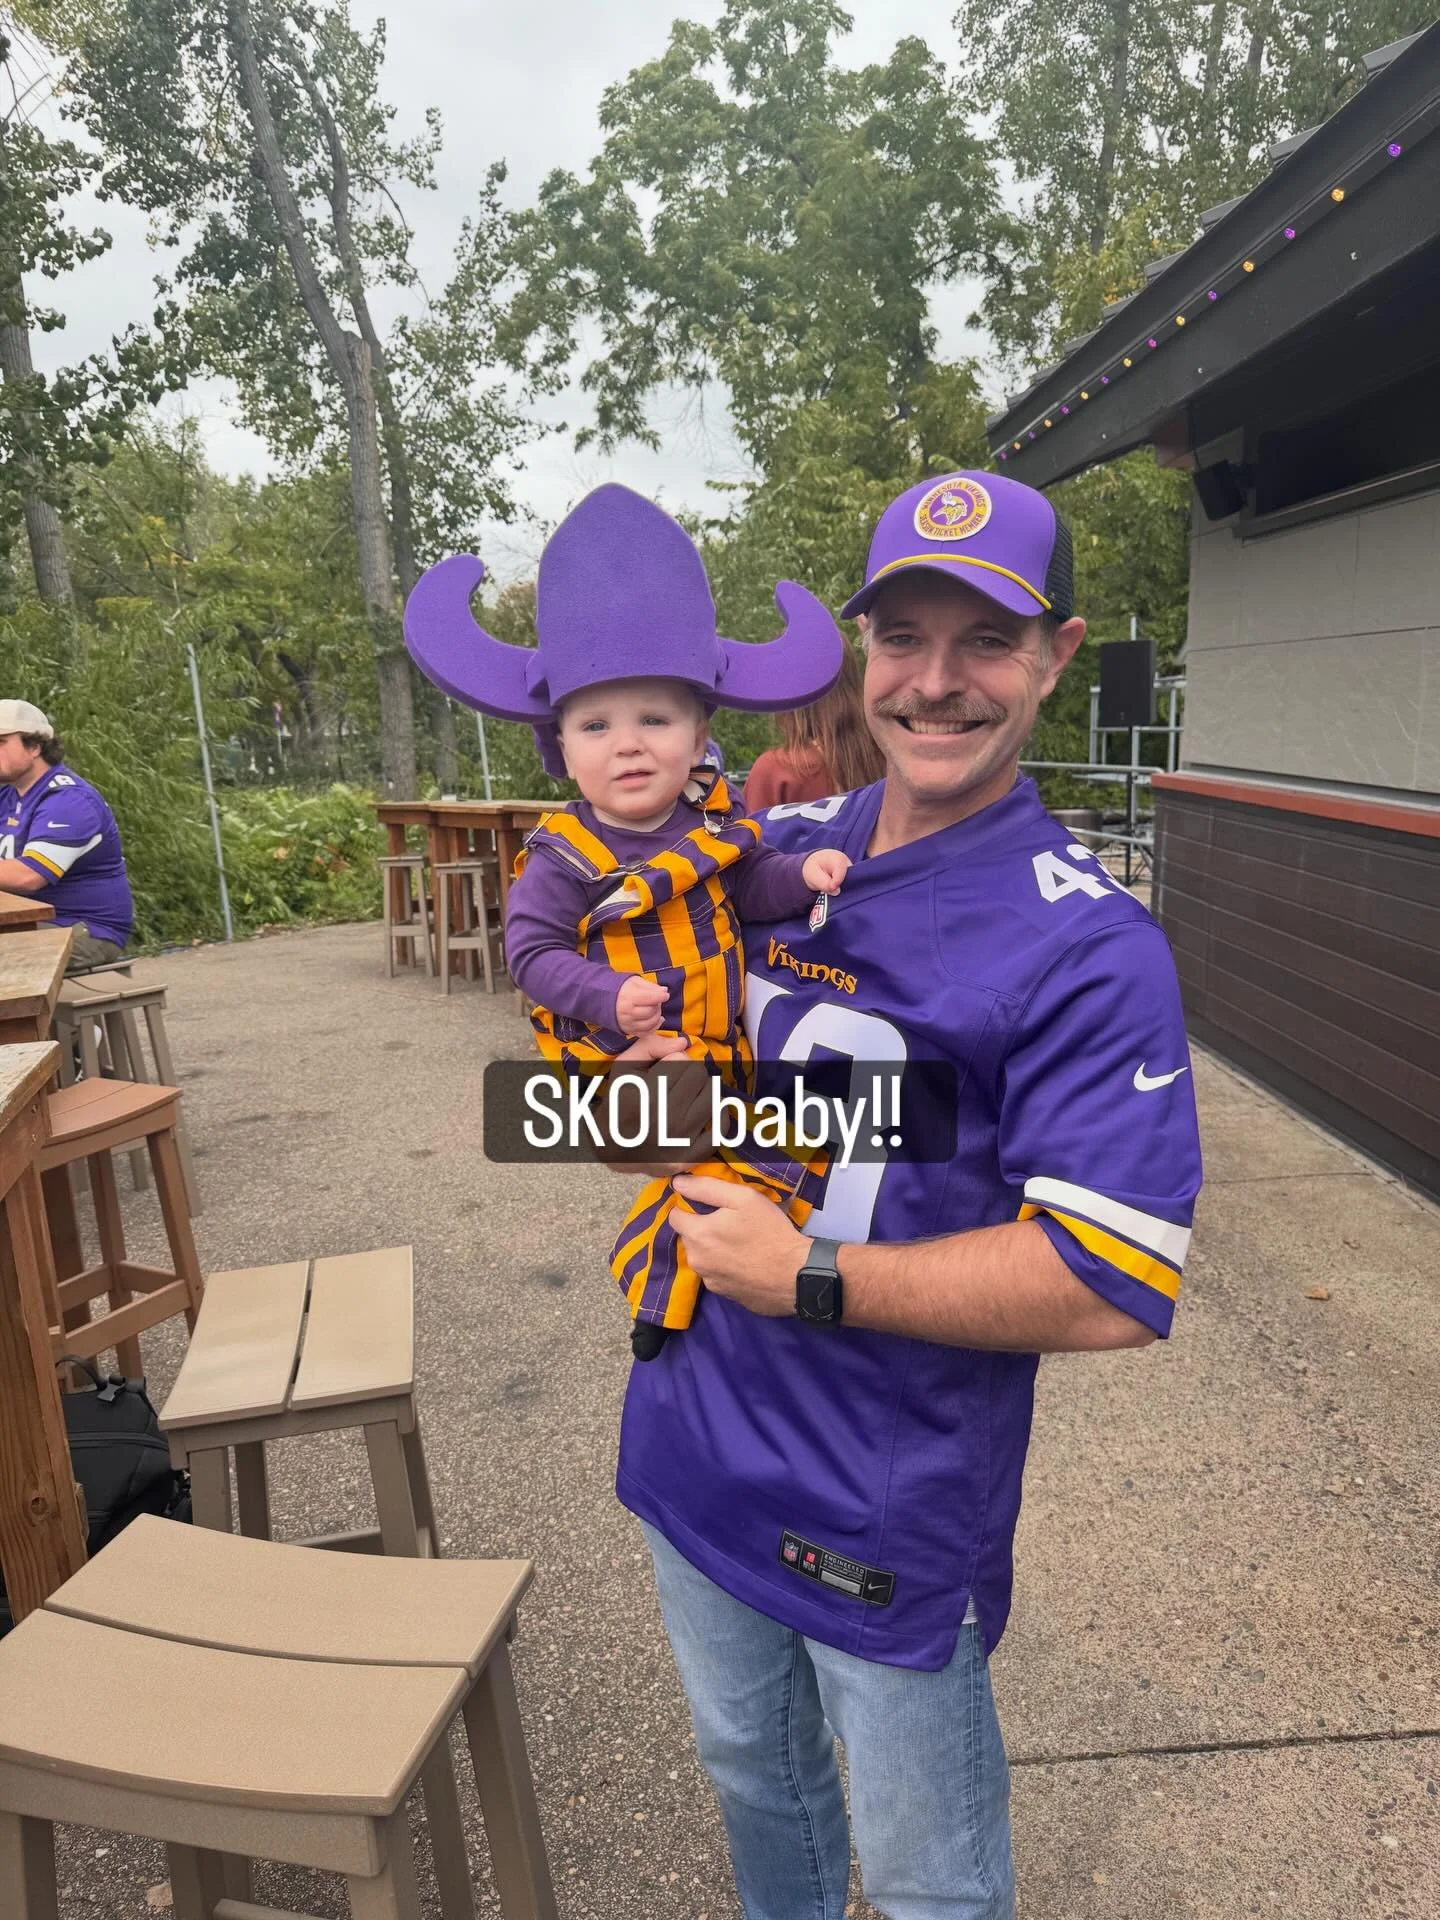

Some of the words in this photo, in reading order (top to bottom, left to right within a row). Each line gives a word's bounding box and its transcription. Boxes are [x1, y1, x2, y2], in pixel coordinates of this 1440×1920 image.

[964, 482, 987, 508] VIKINGS
[933, 525, 960, 537] TICKET
[959, 512, 985, 536] MEMBER
